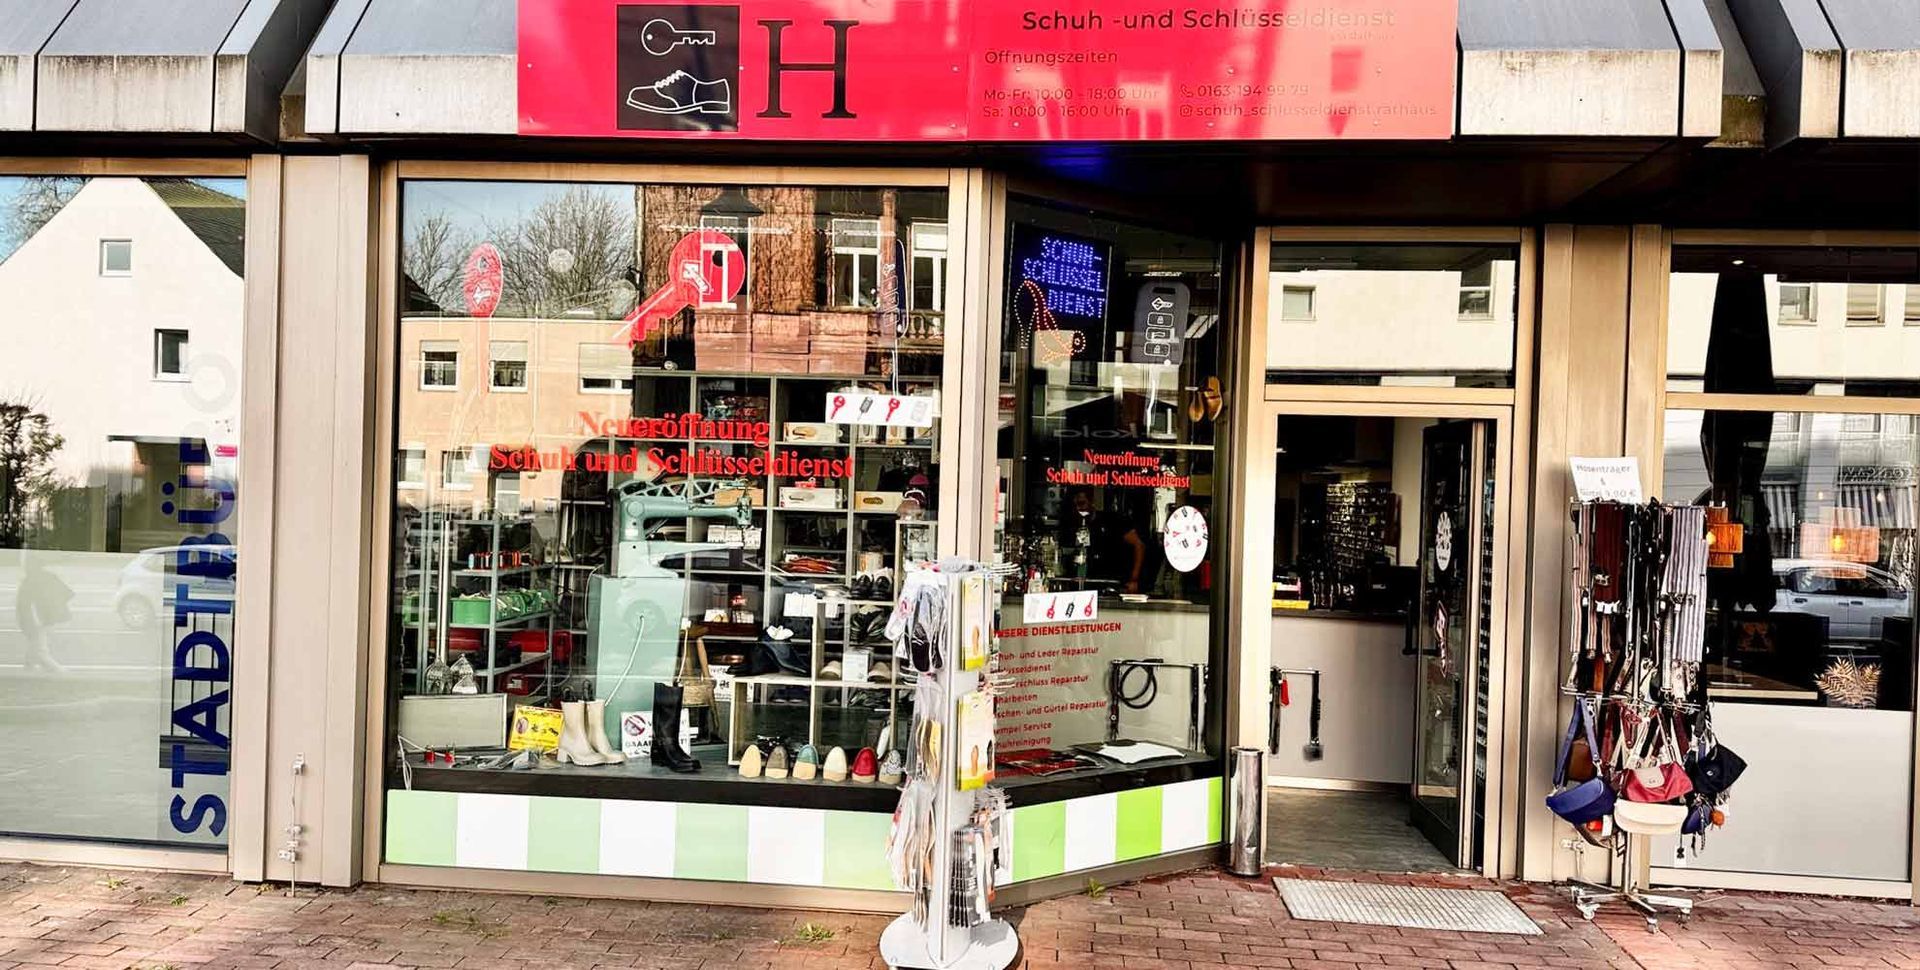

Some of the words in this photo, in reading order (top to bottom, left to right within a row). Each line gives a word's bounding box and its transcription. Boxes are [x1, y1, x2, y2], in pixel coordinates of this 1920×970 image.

[1022, 10, 1103, 30] Schuh
[1112, 9, 1174, 29] -und
[1183, 9, 1396, 29] Schlüsseldienst
[756, 19, 859, 119] H
[983, 88, 1031, 101] Mo-Fr:
[1035, 88, 1073, 100] 10:00
[1087, 87, 1127, 100] 18:00
[1131, 87, 1160, 99] Uhr
[1197, 84, 1230, 98] 0163
[1236, 84, 1262, 98] 194
[983, 106, 1004, 118] Sa:
[1008, 105, 1047, 117] 10:00
[1060, 105, 1099, 117] 16:00
[1103, 105, 1131, 117] Uhr
[1047, 289, 1106, 319] DIENST
[578, 410, 770, 447] Neueröffnung
[490, 443, 578, 471] Schuh
[585, 446, 638, 473] und
[645, 447, 855, 478] Schlüsseldienst
[1046, 467, 1084, 484] Schuh
[1086, 470, 1109, 485] und
[1111, 469, 1191, 488] Schlüsseldienst
[1031, 622, 1122, 637] DIENSTLEISTUNGEN
[1019, 650, 1035, 660] und
[1037, 648, 1060, 659] Leder
[1062, 646, 1099, 658] Reparatur
[1050, 675, 1089, 687] Reparatur
[1070, 699, 1107, 711] Reparatur
[1023, 721, 1052, 733] Service
